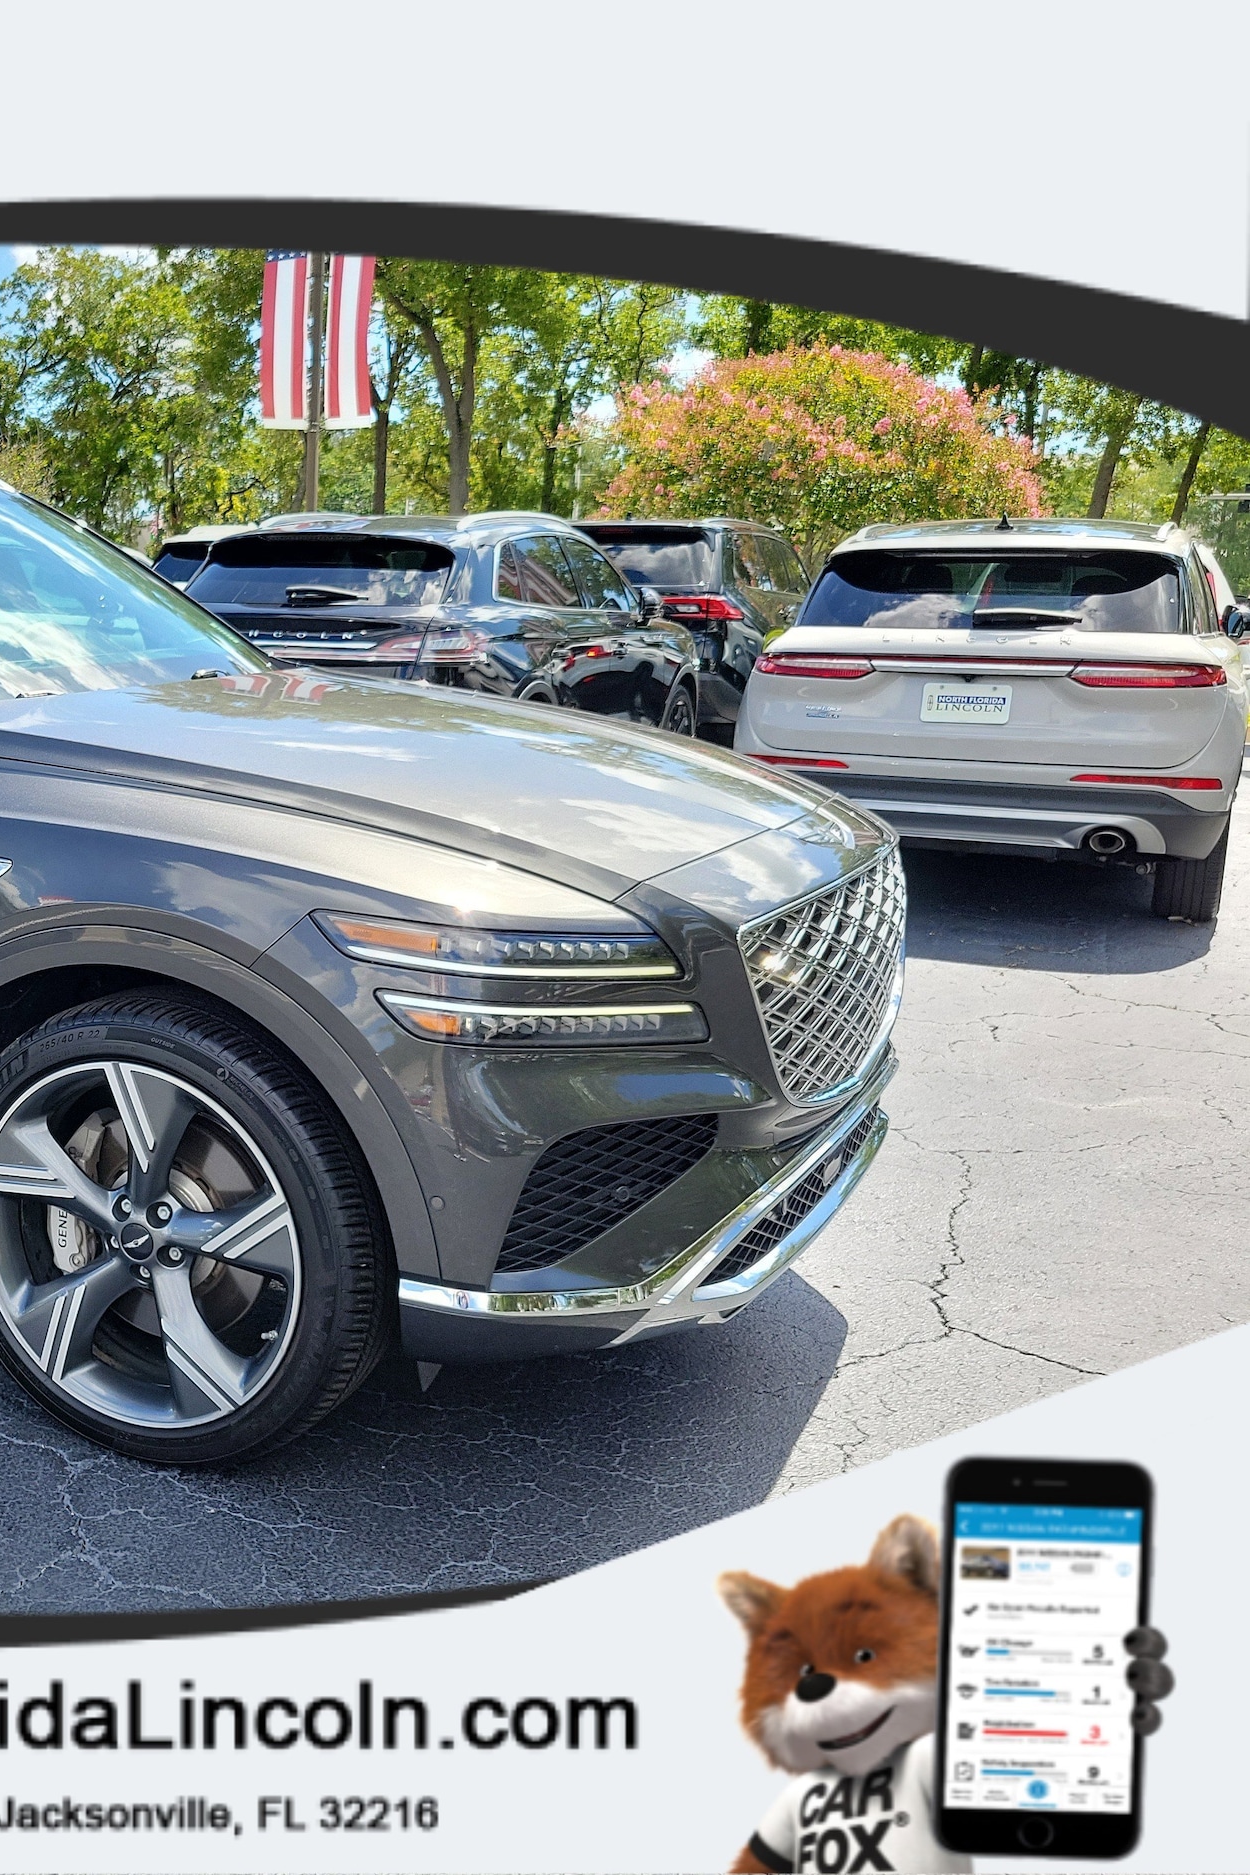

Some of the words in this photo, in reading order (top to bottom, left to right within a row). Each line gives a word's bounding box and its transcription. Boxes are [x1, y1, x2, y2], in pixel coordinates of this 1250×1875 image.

[882, 634, 1072, 646] LINCOLN
[938, 696, 968, 704] NORTH
[969, 697, 1004, 705] FLORIDA
[935, 703, 1003, 713] LINCOLN
[39, 1033, 74, 1052] 265/40
[77, 1031, 84, 1040] R
[87, 1029, 101, 1039] 22
[150, 1037, 176, 1049] OUTSIDE
[1093, 1644, 1104, 1659] 5
[1090, 1725, 1101, 1739] 3
[1088, 1765, 1100, 1779] 9
